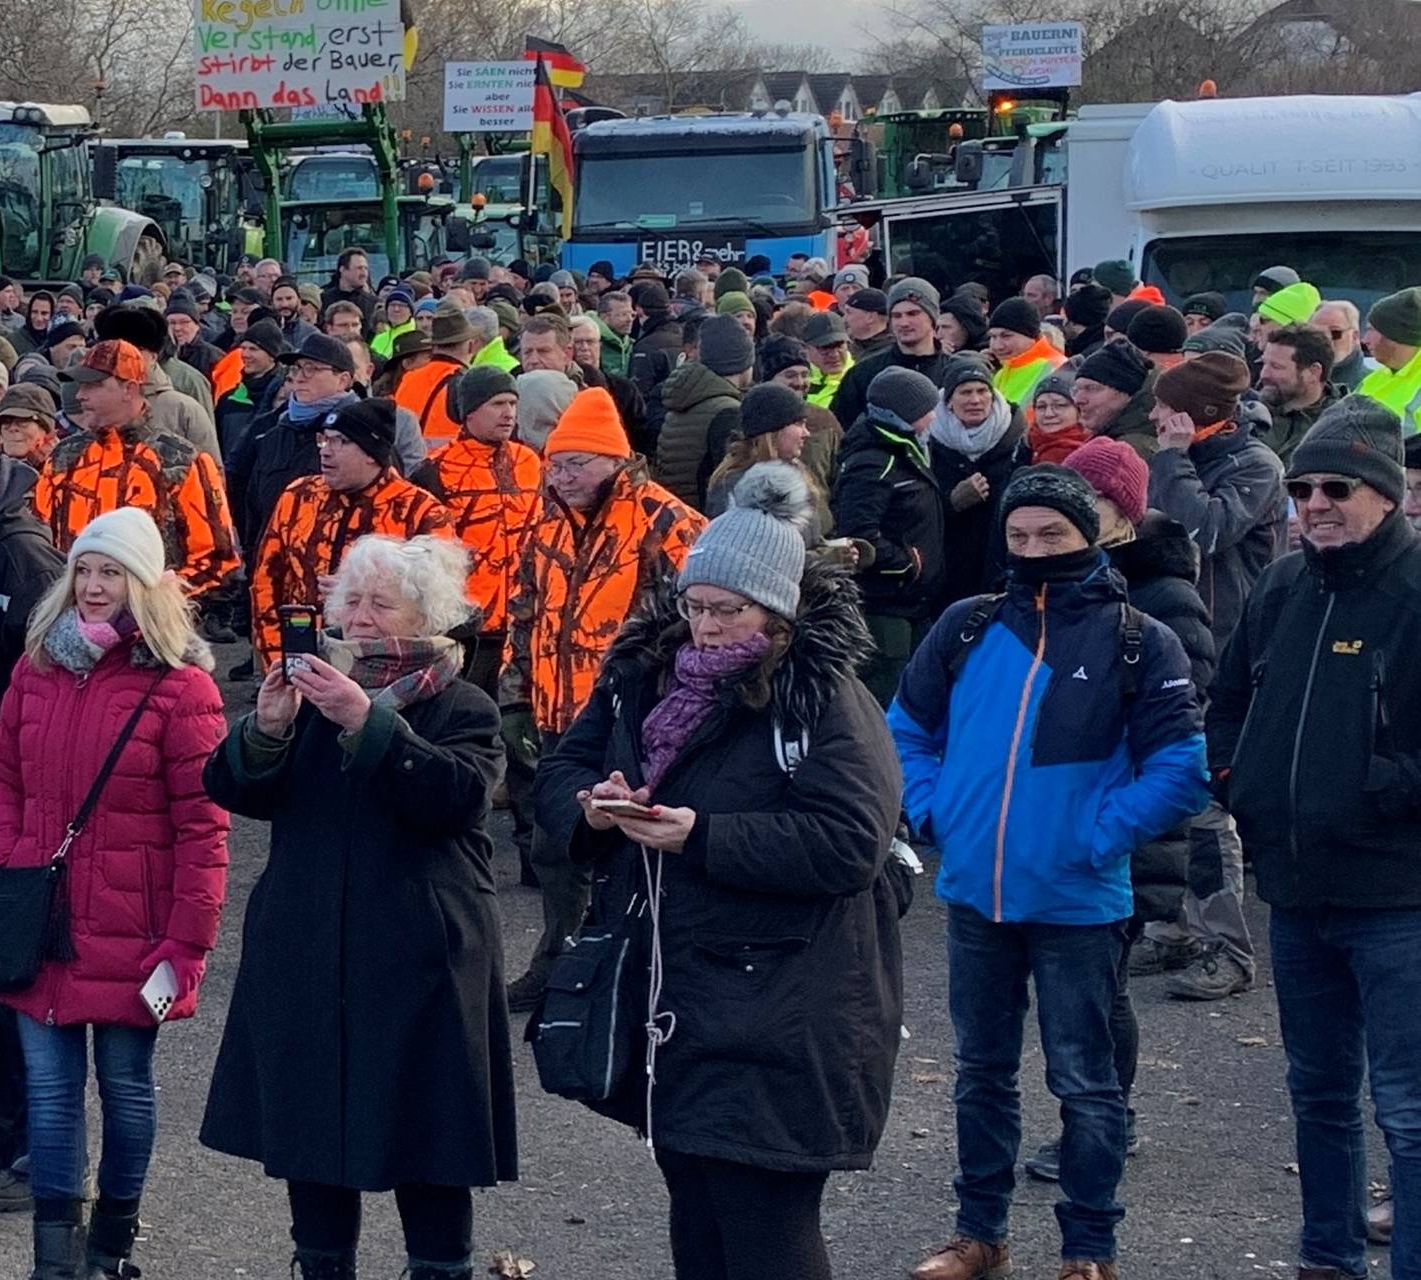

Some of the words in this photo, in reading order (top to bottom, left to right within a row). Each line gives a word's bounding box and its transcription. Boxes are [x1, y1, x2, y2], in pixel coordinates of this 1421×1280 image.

[329, 20, 394, 46] erst
[198, 53, 277, 75] stirbt
[283, 53, 322, 72] der
[457, 68, 472, 76] Sie
[448, 81, 465, 89] Sie
[466, 80, 513, 89] ERNTEN
[200, 84, 258, 109] Dann
[273, 81, 317, 106] das
[485, 92, 510, 101] aber
[453, 105, 468, 114] Sie
[471, 105, 515, 113] WISSEN
[479, 118, 515, 126] besser
[1311, 159, 1357, 174] SEIT
